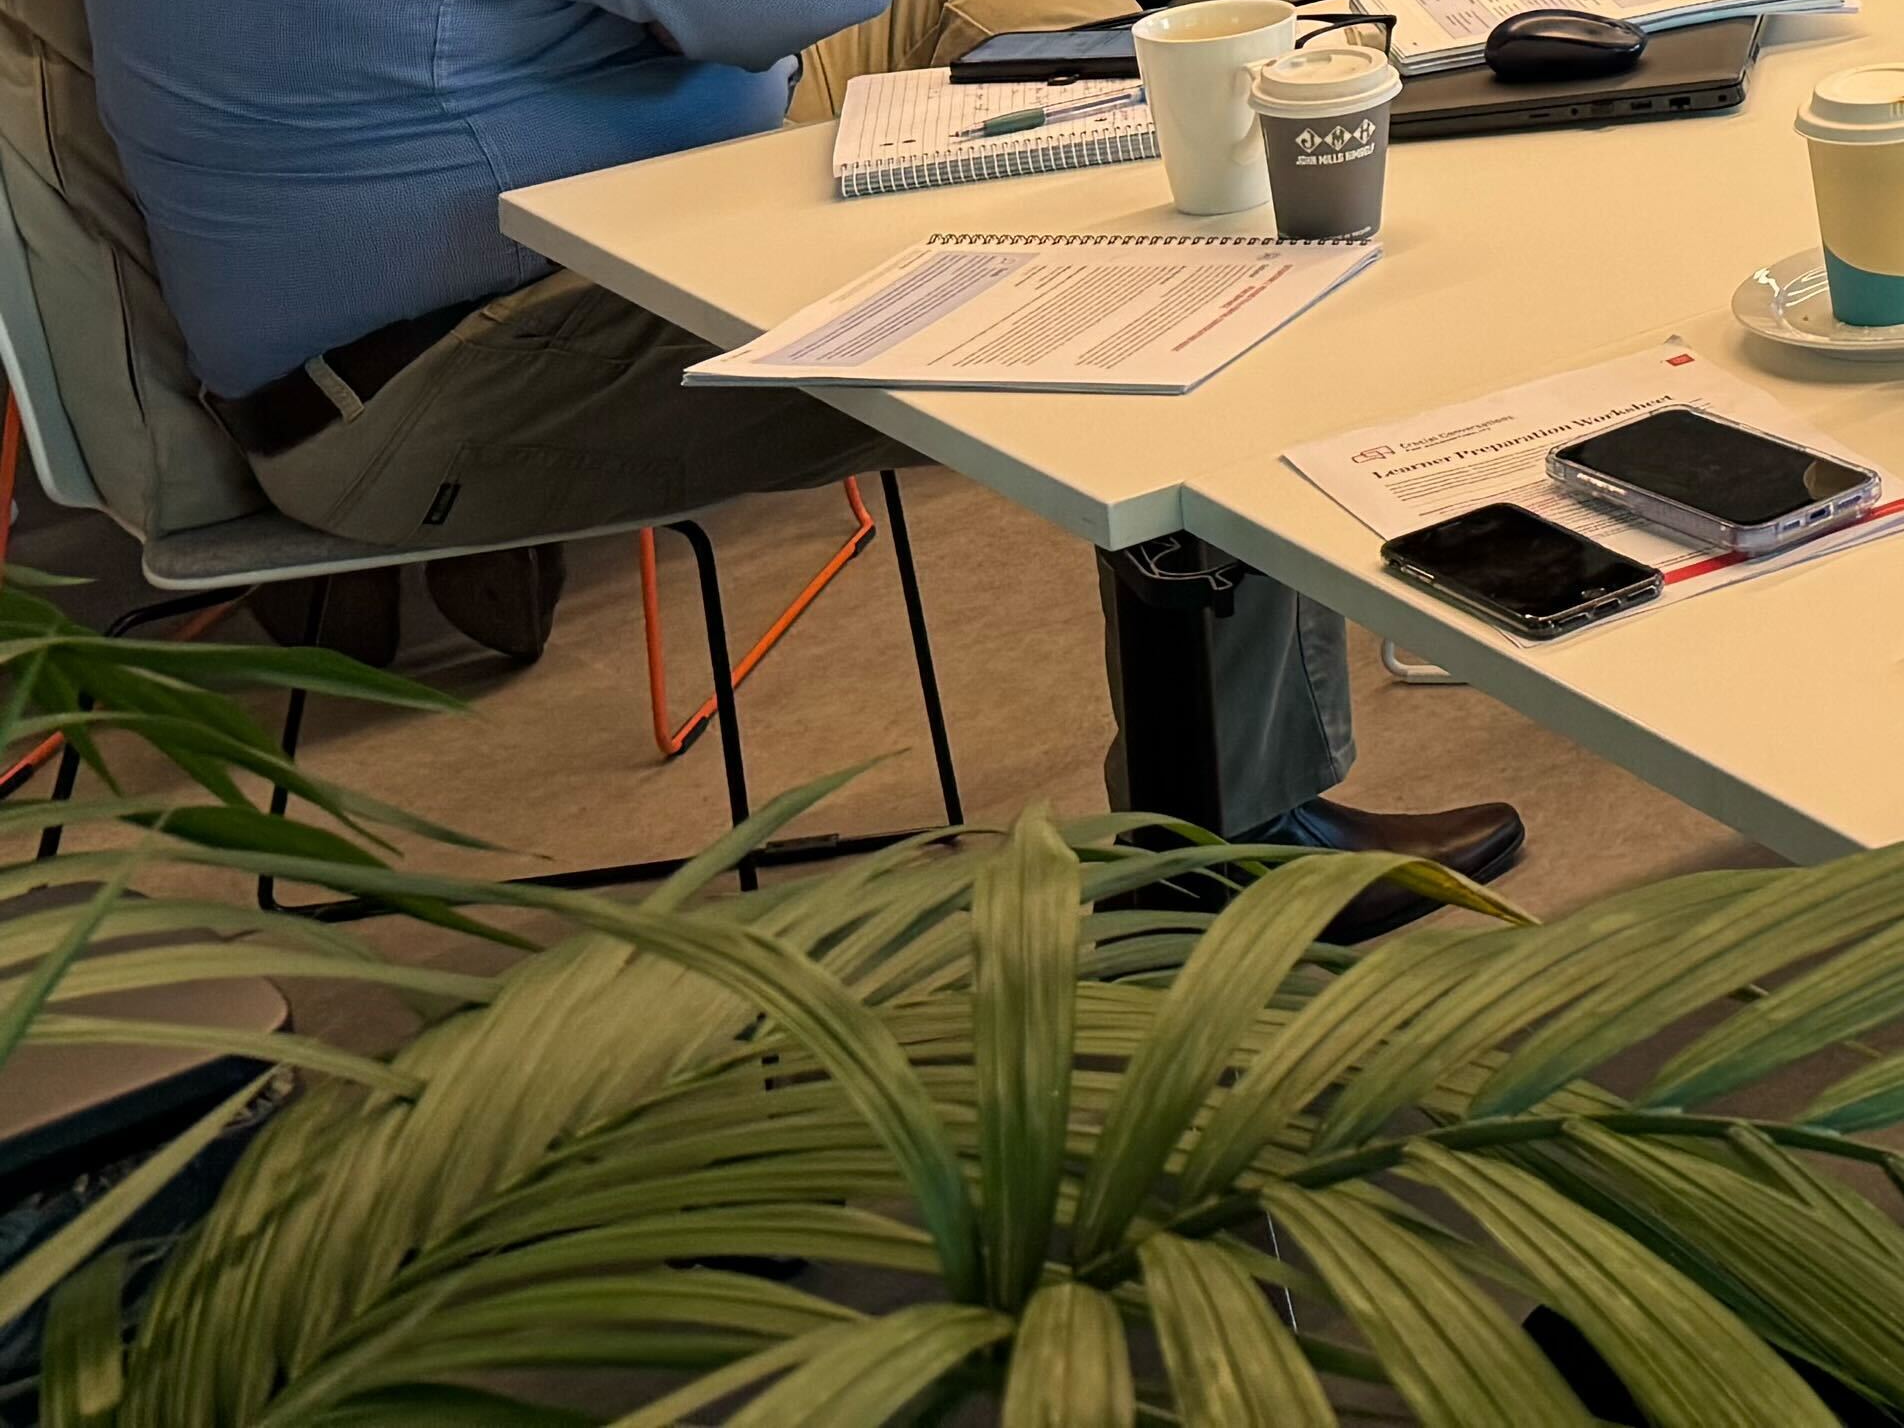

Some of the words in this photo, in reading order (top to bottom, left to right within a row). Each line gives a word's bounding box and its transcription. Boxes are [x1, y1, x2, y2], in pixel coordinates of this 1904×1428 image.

[1370, 454, 1453, 481] Learner
[1455, 422, 1573, 460] Preparation
[1570, 393, 1676, 428] Worksheet
